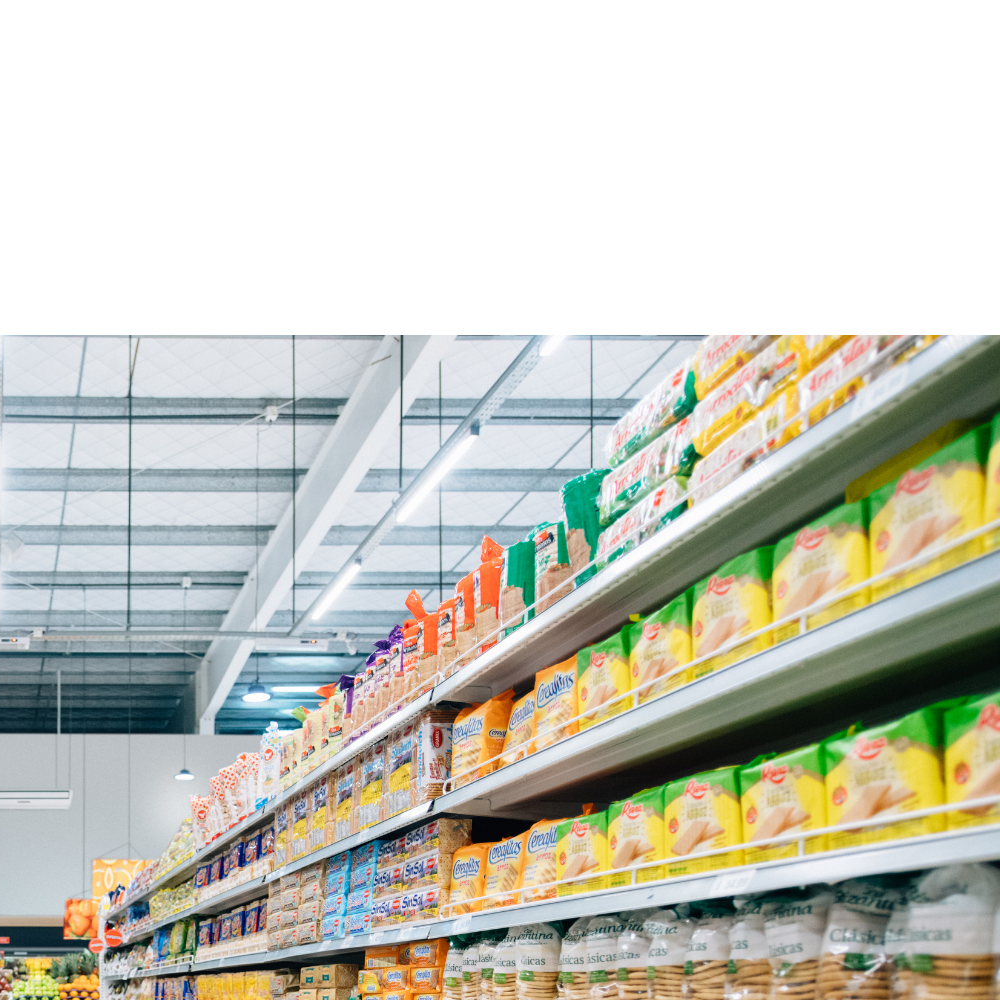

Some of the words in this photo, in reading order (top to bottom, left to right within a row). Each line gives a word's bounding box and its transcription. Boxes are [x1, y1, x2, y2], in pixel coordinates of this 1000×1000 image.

[536, 671, 575, 707] Cerealitas
[459, 740, 472, 750] arroz
[489, 838, 522, 865] Cerealitas
[528, 827, 557, 854] Cerealit
[453, 857, 481, 880] Cerealitas
[536, 853, 551, 861] arroz
[587, 953, 617, 964] ásicas
